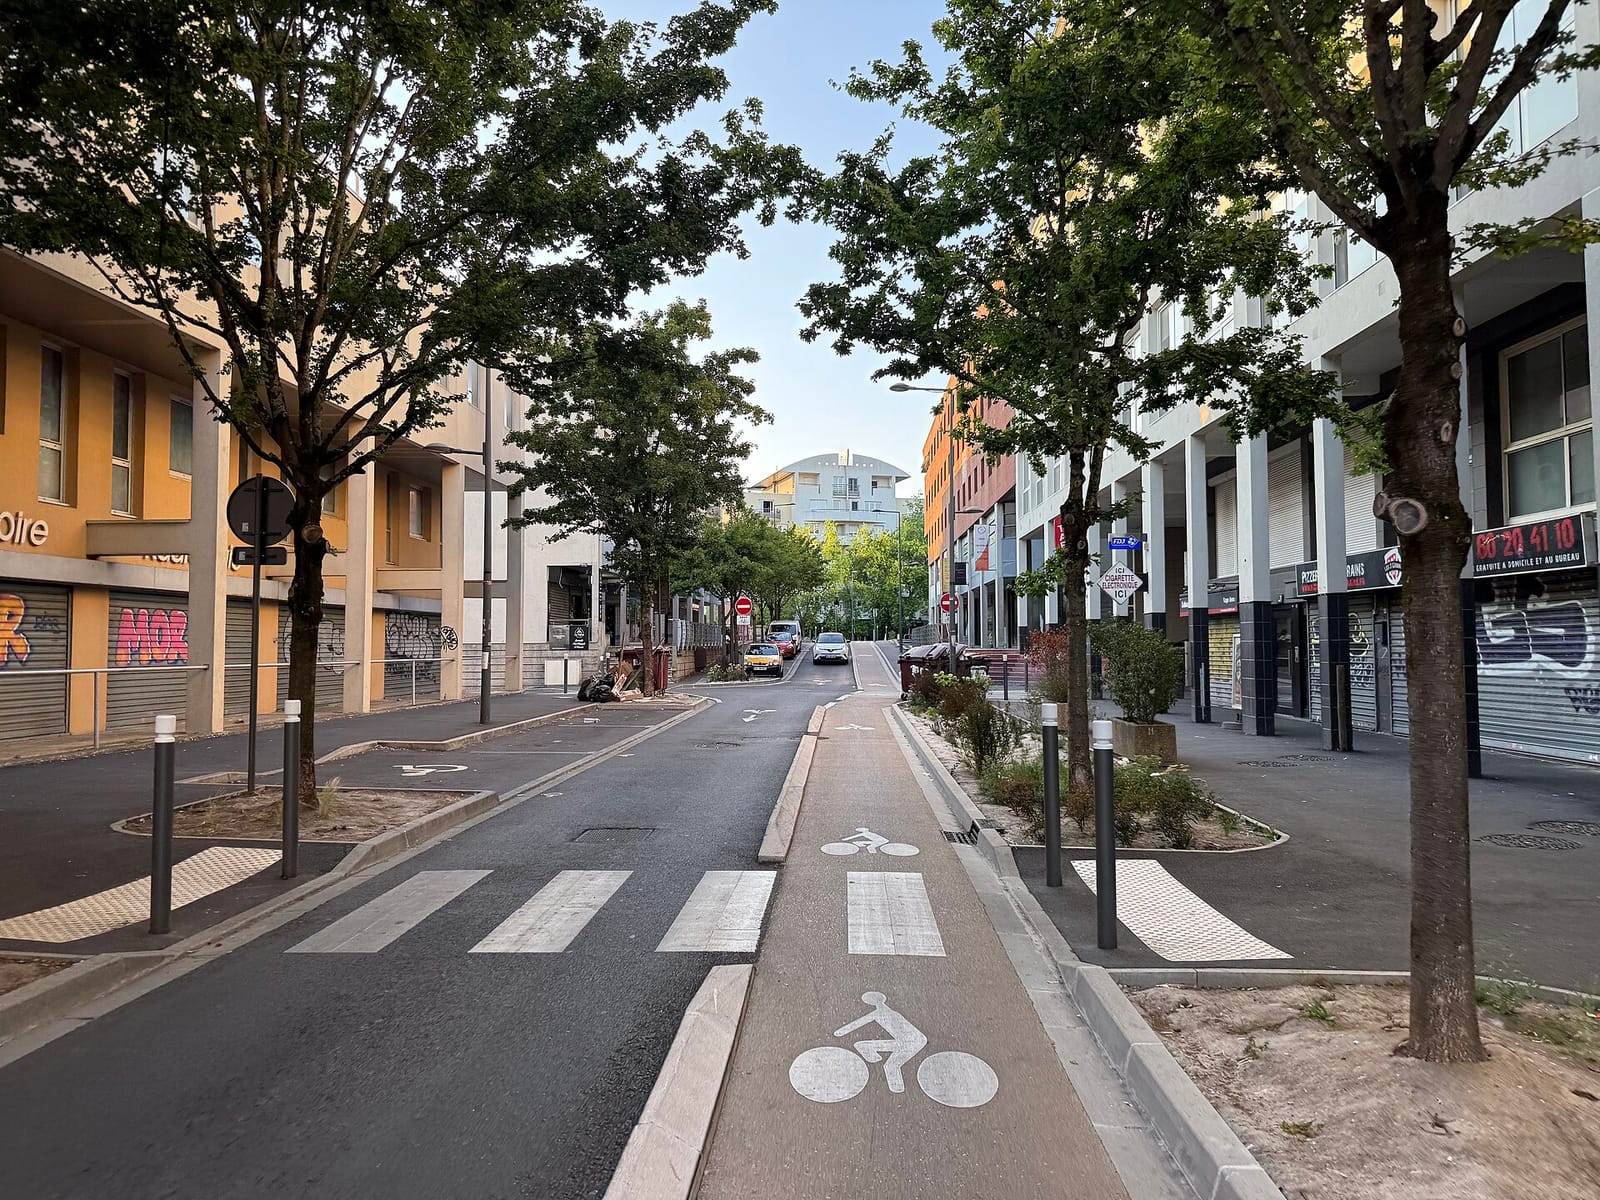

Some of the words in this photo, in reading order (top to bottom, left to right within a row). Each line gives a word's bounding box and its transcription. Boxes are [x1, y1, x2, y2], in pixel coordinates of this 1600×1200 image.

[1502, 527, 1523, 556] 20
[1530, 524, 1548, 552] 41
[1554, 518, 1575, 550] 10
[1475, 562, 1500, 572] GRATUITE
[1508, 558, 1533, 569] DOMICILE
[1535, 556, 1544, 565] ET
[1544, 555, 1553, 564] AU
[1555, 552, 1580, 563] BUREAU
[1104, 574, 1135, 582] CIGARETTE
[1114, 589, 1127, 598] ICI
